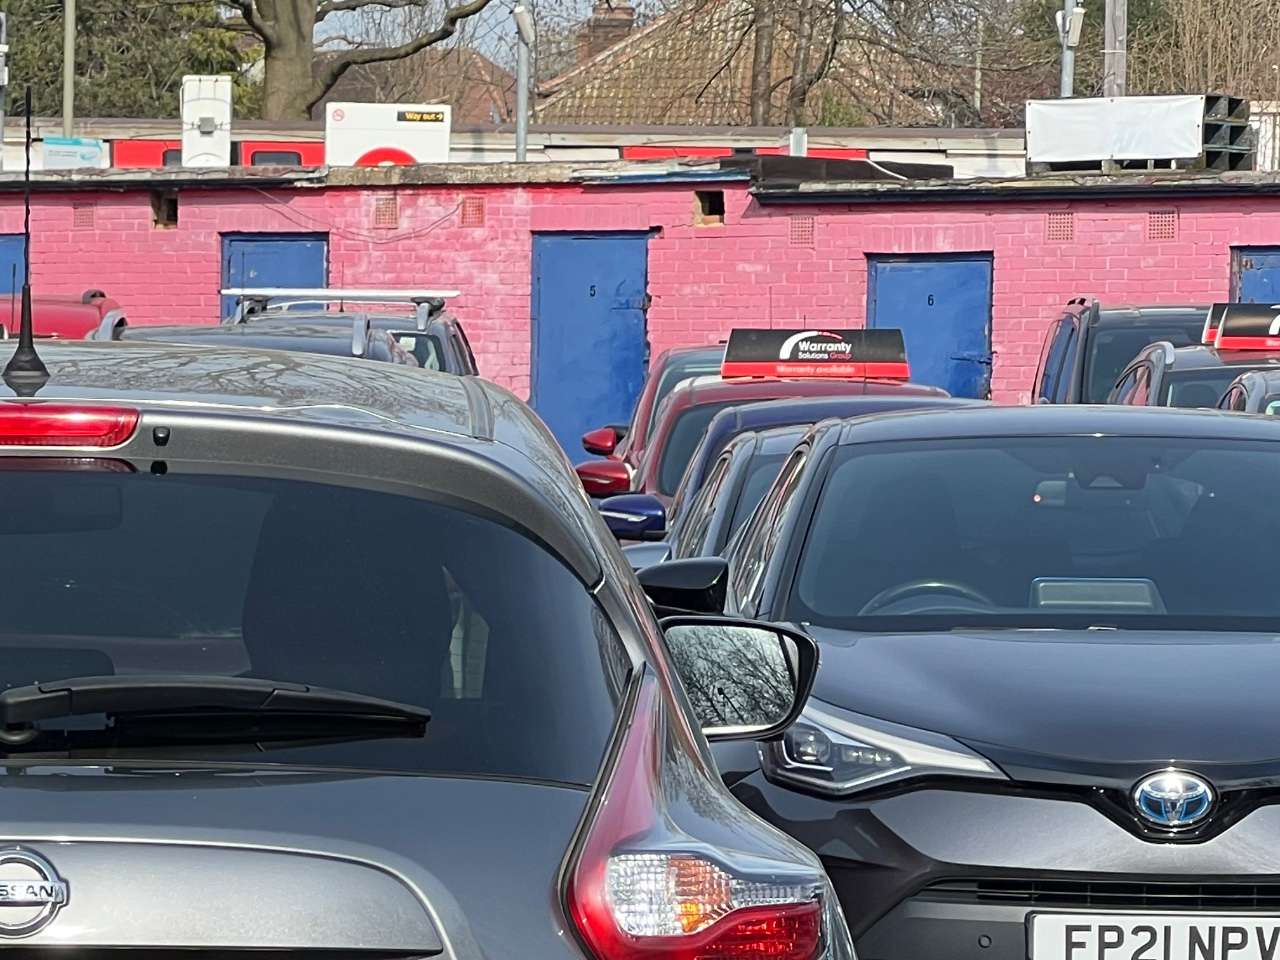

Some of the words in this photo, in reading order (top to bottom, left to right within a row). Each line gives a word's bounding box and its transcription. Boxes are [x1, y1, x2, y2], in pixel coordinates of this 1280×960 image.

[590, 285, 596, 297] 5
[927, 294, 934, 306] 6
[798, 340, 852, 354] Warranty
[830, 352, 852, 360] Group
